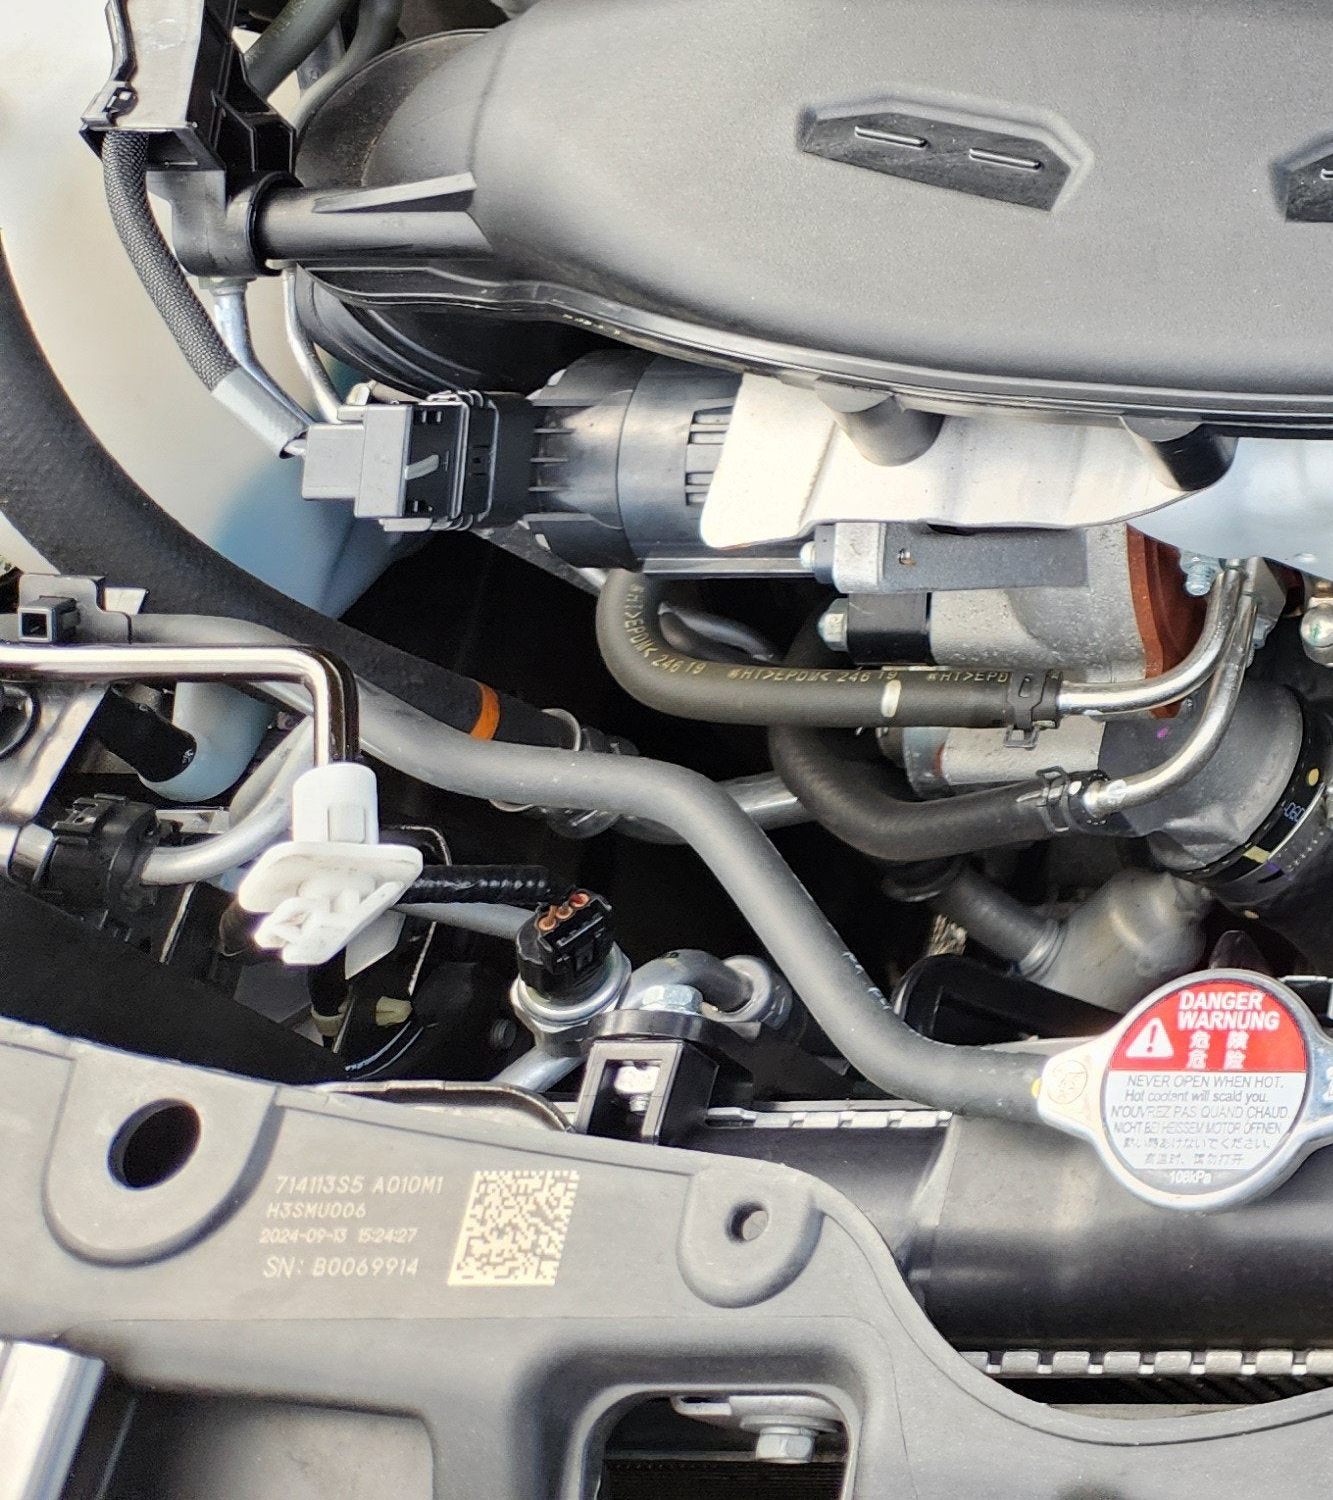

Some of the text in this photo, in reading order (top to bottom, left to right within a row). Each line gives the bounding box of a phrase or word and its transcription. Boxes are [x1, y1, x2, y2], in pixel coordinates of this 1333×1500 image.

[1177, 990, 1264, 1011] DANGER
[1176, 1011, 1281, 1031] WARNUNG
[1127, 1074, 1285, 1089] NEVER OPEN WHEN HOT.
[1124, 1089, 1145, 1102] Hot
[1147, 1089, 1189, 1102] coolant
[1191, 1089, 1210, 1102] will
[1213, 1089, 1242, 1102] scald
[1110, 1105, 1172, 1119] N'OUVREZ
[1173, 1105, 1197, 1119] PAS
[1201, 1105, 1244, 1119] QUAND
[1113, 1121, 1143, 1134] NICHT
[1205, 1121, 1241, 1134] MOTOR
[266, 1201, 367, 1219] H3SMU006
[258, 1226, 418, 1244] 2024-09-13 15:24:27
[262, 1254, 419, 1279] SN: B0069914
